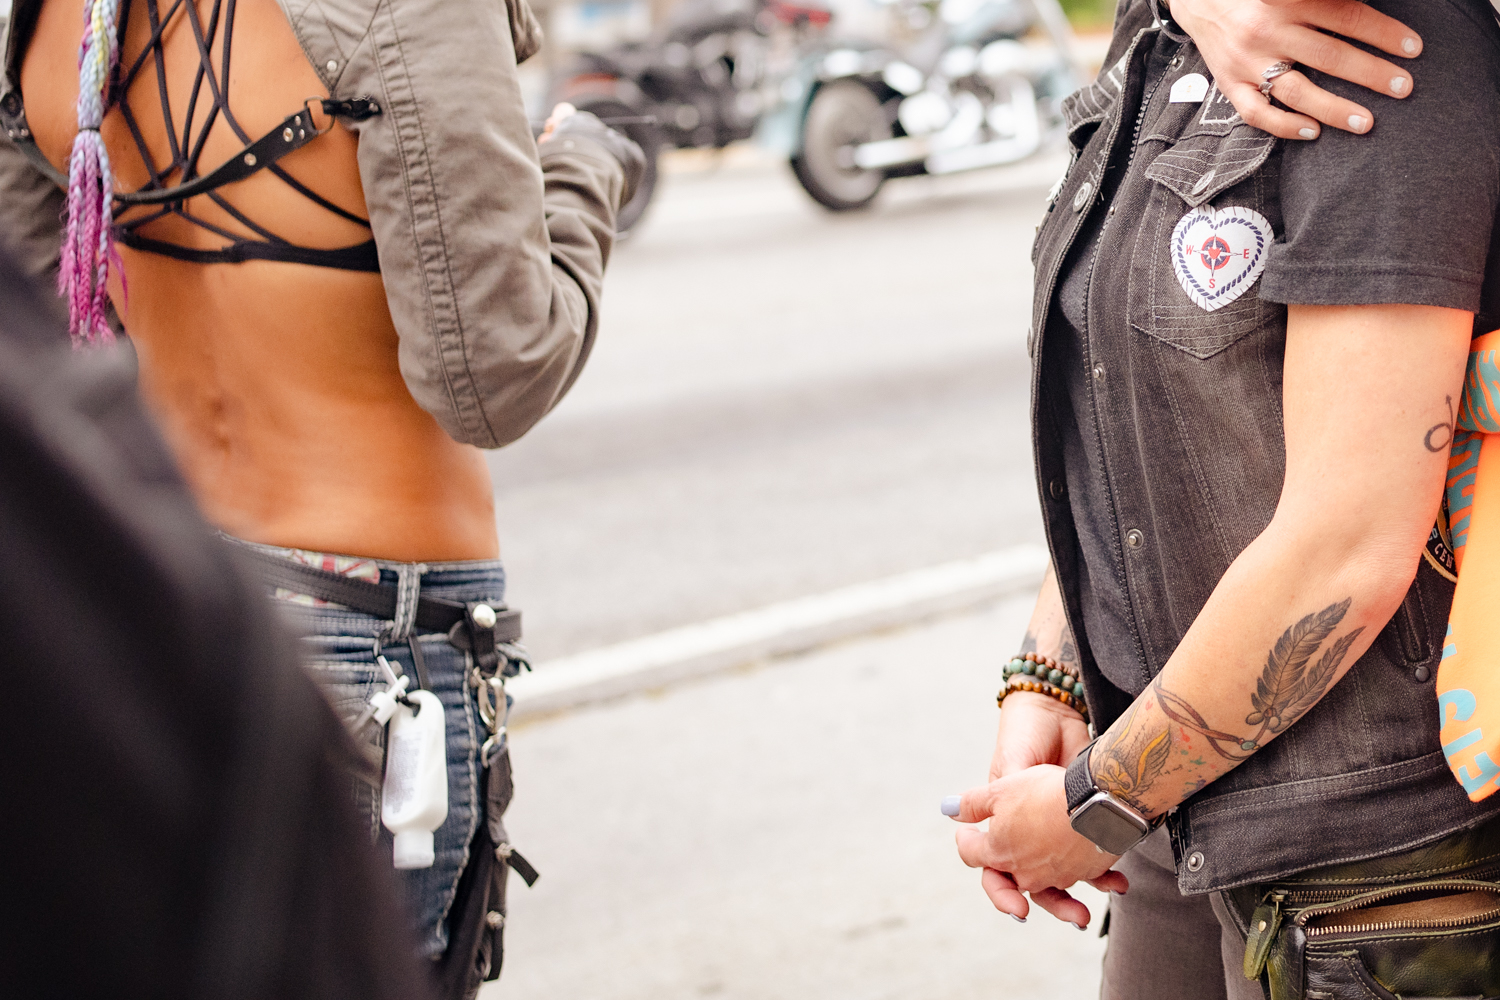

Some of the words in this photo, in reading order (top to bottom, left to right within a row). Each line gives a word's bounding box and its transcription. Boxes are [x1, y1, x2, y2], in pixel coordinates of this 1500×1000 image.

[1185, 244, 1195, 256] W
[1243, 248, 1250, 259] E
[1208, 278, 1216, 289] S
[1434, 542, 1457, 573] CEN
